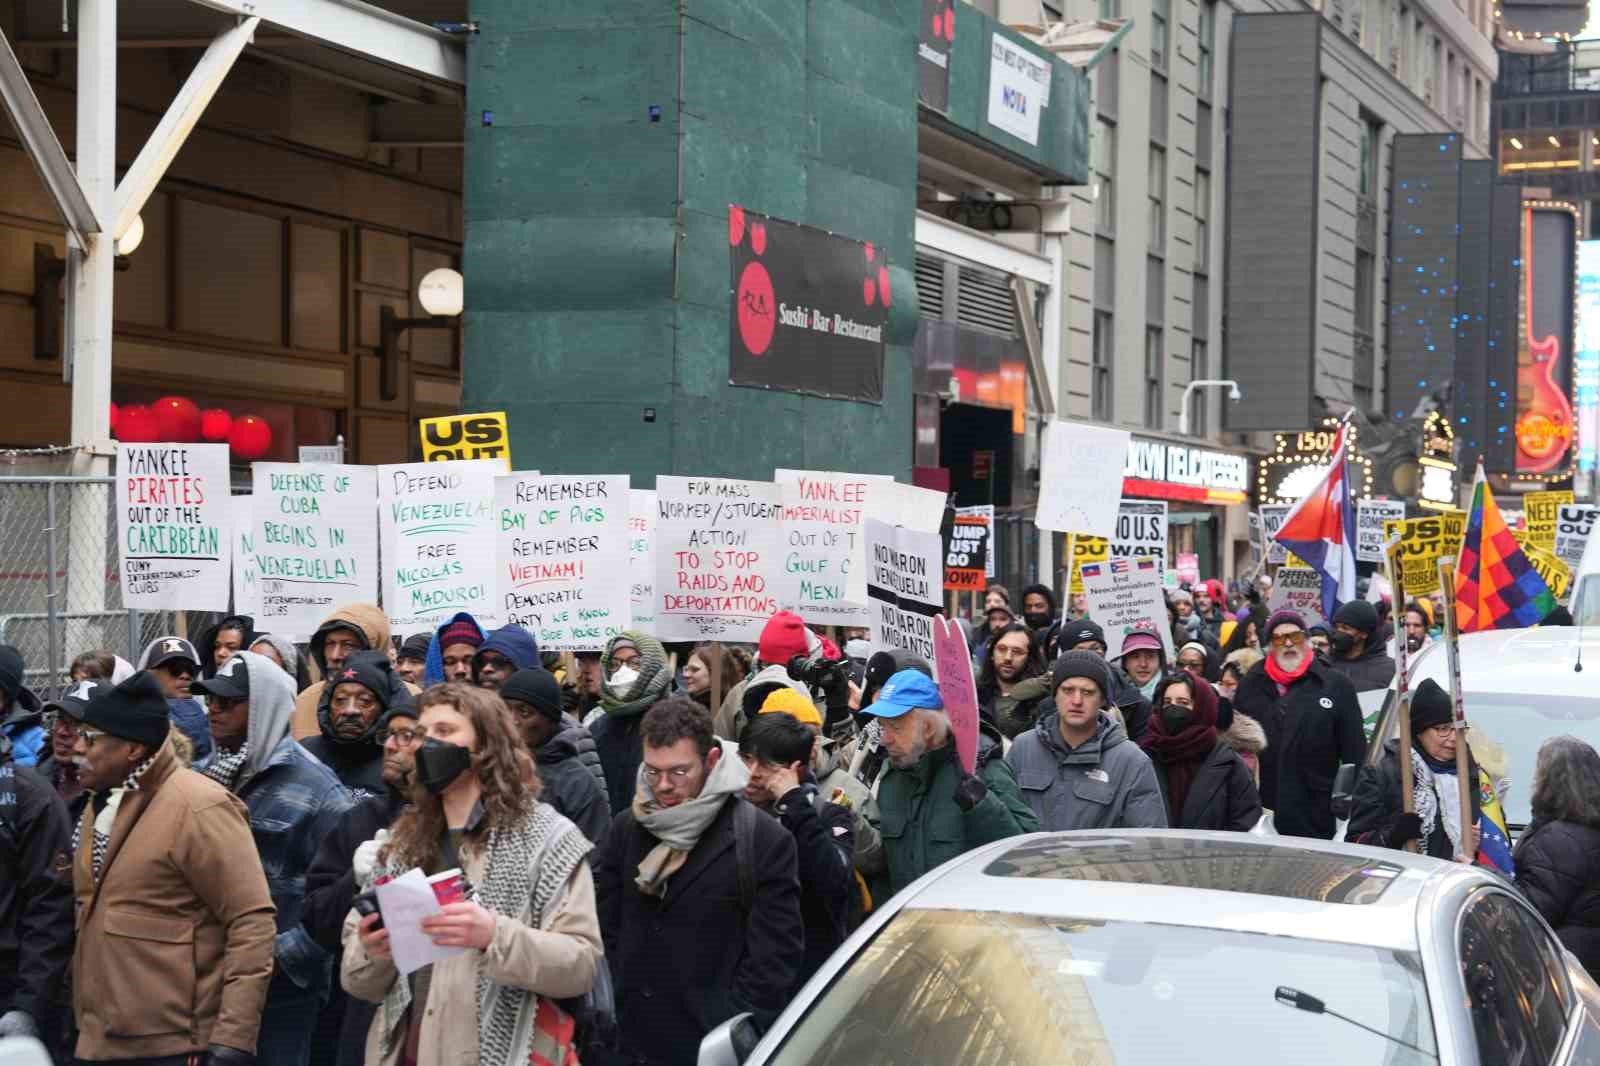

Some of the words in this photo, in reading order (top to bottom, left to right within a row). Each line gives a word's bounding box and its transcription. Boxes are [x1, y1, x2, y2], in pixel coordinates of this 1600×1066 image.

[779, 302, 808, 328] Sushi
[813, 309, 830, 332] Bar
[833, 313, 881, 343] Restaurant
[425, 418, 502, 447] US
[127, 448, 189, 476] YANKEE
[428, 446, 504, 462] OUT
[127, 477, 204, 505] PIRATES
[270, 473, 326, 492] DEFENSE
[334, 476, 350, 493] OF
[393, 470, 462, 495] DEFEND
[515, 480, 608, 504] REMEMBER
[688, 482, 711, 496] FOR
[716, 484, 750, 498] MASS
[799, 478, 867, 502] YANKEE
[128, 507, 151, 523] OUT
[156, 507, 169, 523] OF
[176, 507, 201, 524] THE
[280, 496, 320, 515] CUBA
[391, 499, 494, 524] VENEZUELA!
[659, 501, 783, 526] WORKER/STUDENT
[780, 505, 863, 524] IMPERIALIST
[1361, 507, 1402, 516] STOP
[501, 508, 526, 531] BAY
[538, 509, 561, 525] OF
[570, 505, 605, 523] PIGS
[1561, 508, 1600, 524] US
[264, 521, 317, 548] BEGINS
[328, 528, 344, 548] IN
[1134, 516, 1164, 541] U.S.
[1386, 520, 1441, 540] US
[1444, 520, 1461, 535] NO
[127, 526, 218, 554] CARIBBEAN
[512, 536, 600, 557] REMEMBER
[688, 529, 747, 547] ACTION
[788, 530, 817, 546] OUT
[823, 530, 839, 546] OF
[417, 543, 457, 560] FREE
[1110, 544, 1164, 558] WAR
[1360, 545, 1380, 553] NO
[126, 561, 150, 572] CUNY
[256, 555, 356, 580] VENEZUELA!
[675, 552, 700, 569] TO
[714, 550, 759, 569] STOP
[785, 552, 829, 573] GULF
[875, 543, 888, 564] NO
[909, 556, 926, 576] ON
[947, 553, 969, 566] GO
[509, 560, 584, 581] VIETNAM!
[1113, 575, 1129, 584] End
[1279, 570, 1318, 580] DEFEND
[128, 581, 159, 594] CLUBS
[677, 571, 728, 592] RAIDS
[732, 576, 766, 593] AND
[800, 580, 845, 600] MEXI
[411, 584, 486, 607] MADURO!
[505, 588, 584, 610] DEMOCRATIC
[664, 595, 777, 615] DEPORTATIONS
[1116, 591, 1133, 600] and
[508, 612, 542, 626] PARTY
[552, 611, 569, 623] WE
[578, 608, 610, 621] KNOW
[882, 605, 895, 626] NO
[916, 619, 931, 639] ON
[1115, 609, 1124, 617] of
[541, 628, 563, 641] SIDE
